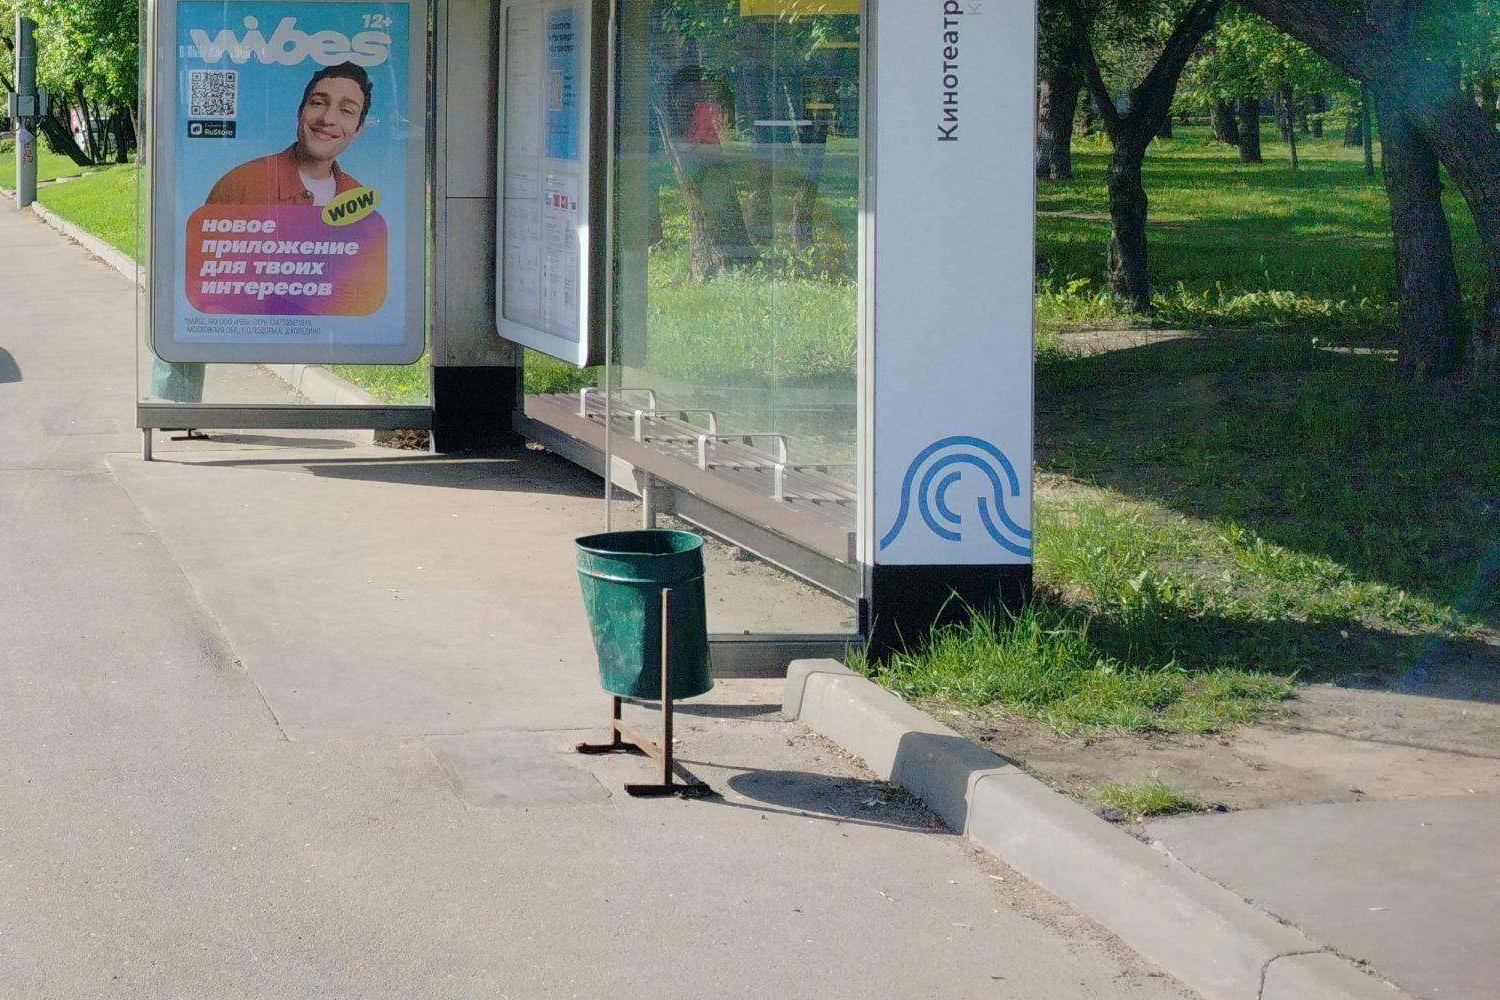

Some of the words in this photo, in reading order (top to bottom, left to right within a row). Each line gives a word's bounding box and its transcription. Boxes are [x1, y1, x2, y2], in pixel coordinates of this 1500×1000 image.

[361, 13, 393, 28] 12+
[189, 15, 393, 67] vibes
[937, 0, 964, 142] Кинотеатр
[204, 128, 234, 136] RuStore
[327, 190, 375, 222] WOW
[201, 219, 277, 234] новое
[201, 239, 360, 258] приложение
[199, 260, 247, 277] для
[253, 260, 326, 276] твоих
[201, 280, 333, 301] интересов
